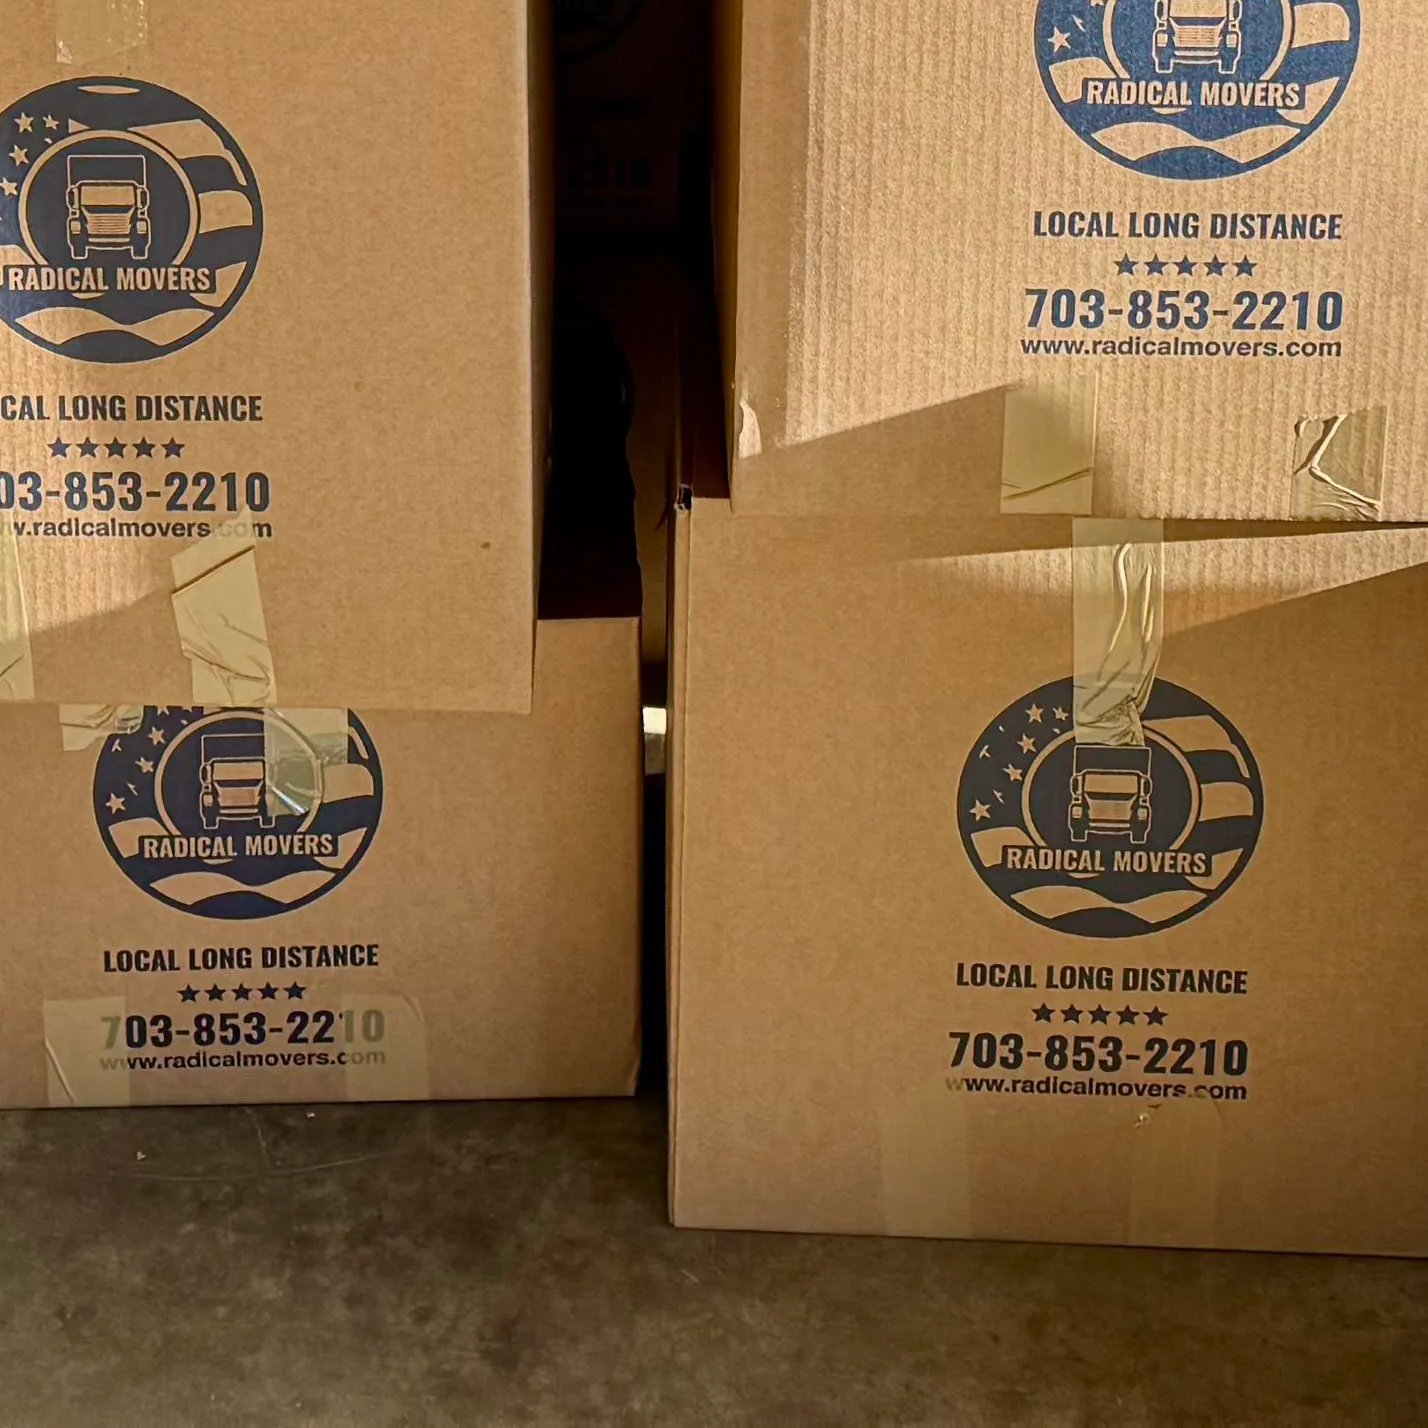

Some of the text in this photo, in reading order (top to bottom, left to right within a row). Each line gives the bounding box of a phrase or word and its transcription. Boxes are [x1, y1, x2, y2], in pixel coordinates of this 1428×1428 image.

[1086, 79, 1300, 108] RADICAL MOVERS
[1034, 211, 1343, 240] LOCAL LONG DISTANCE
[8, 267, 210, 292] RADICAL MOVERS
[1024, 288, 1343, 331] 703-853-2210
[1020, 335, 1342, 358] www.radicalmovers.com
[58, 395, 126, 421] LONG
[135, 395, 263, 422] DISTANCE
[143, 834, 333, 858] RADICAL MOVERS
[1006, 848, 1207, 874] RADICAL MOVERS
[104, 944, 379, 973] LOCAL LONG DISTANCE
[956, 963, 1248, 994] LOCAL LONG DISTANCE
[100, 1009, 385, 1051] 703-853-2210
[100, 1048, 386, 1071] www.radicalmovers.com
[949, 1032, 1249, 1076] 703-853-2210
